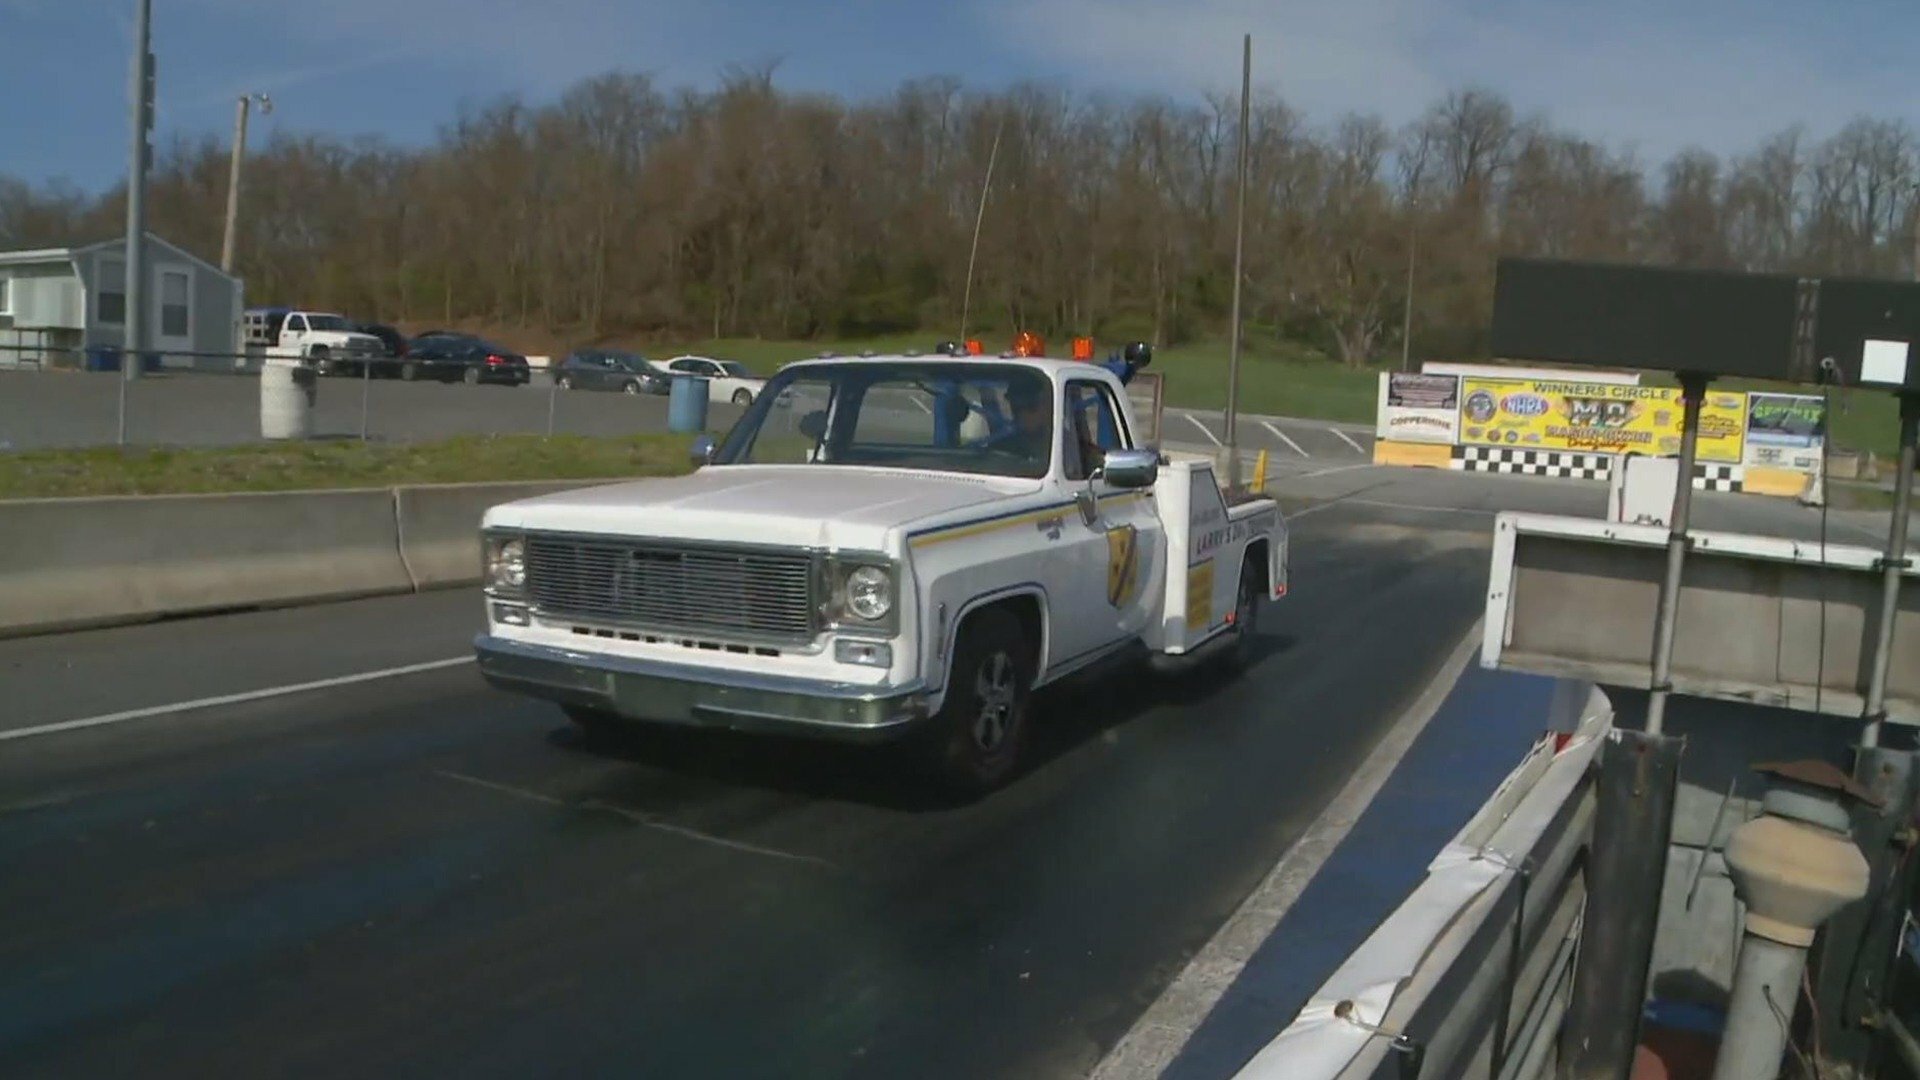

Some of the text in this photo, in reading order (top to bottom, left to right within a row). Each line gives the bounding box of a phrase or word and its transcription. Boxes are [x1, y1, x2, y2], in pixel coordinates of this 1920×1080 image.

[1533, 382, 1606, 397] WINNERS
[1611, 387, 1671, 400] CIRCLE
[1506, 394, 1543, 415] NHRA
